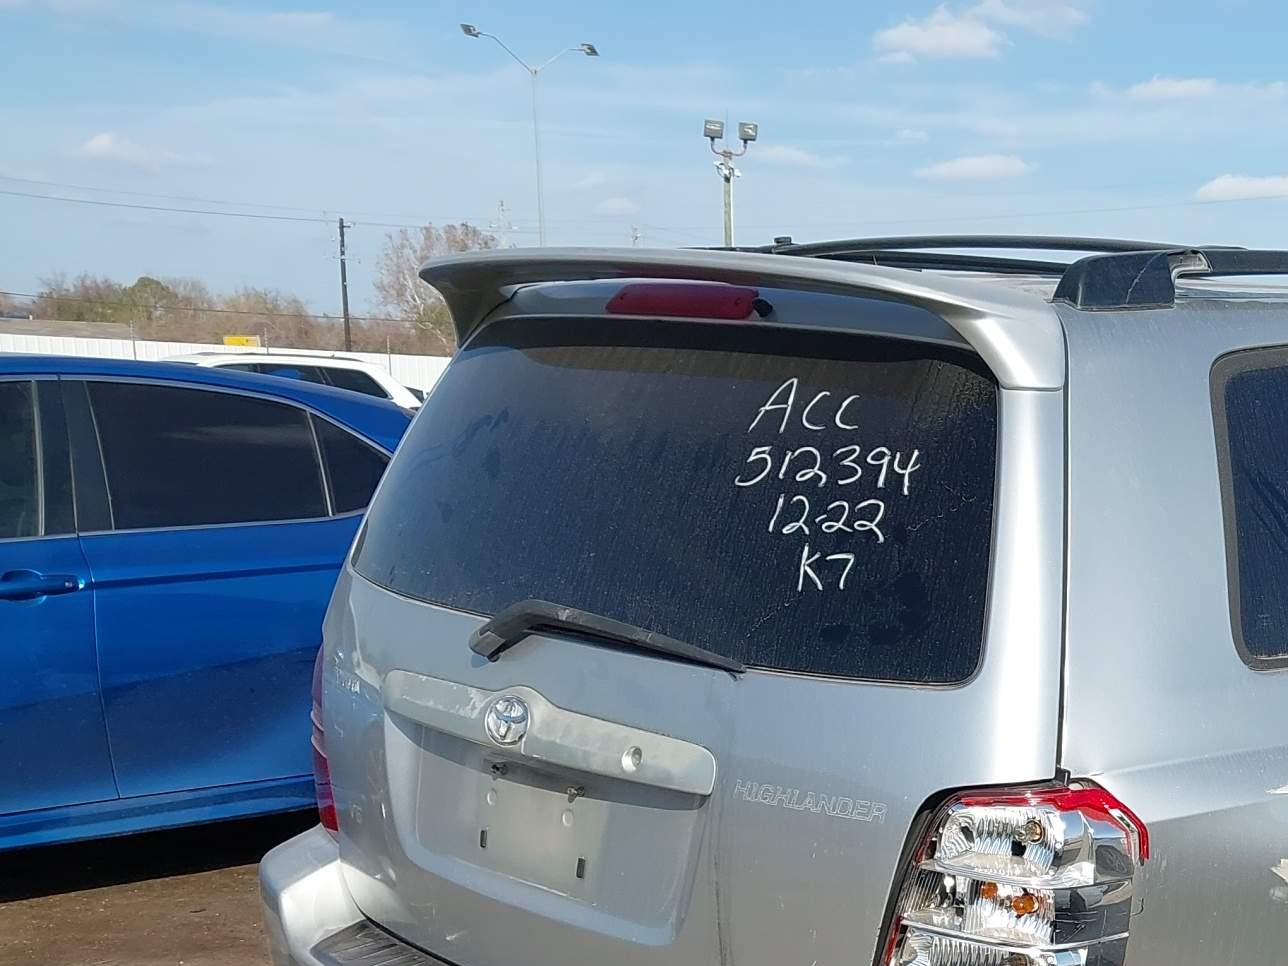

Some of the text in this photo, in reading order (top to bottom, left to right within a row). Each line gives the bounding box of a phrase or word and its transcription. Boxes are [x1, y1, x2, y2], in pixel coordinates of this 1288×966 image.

[748, 377, 860, 434] ACC
[734, 444, 921, 496] 512394
[768, 493, 885, 544] 12-22
[797, 542, 855, 592] K7
[733, 779, 888, 824] HIGHLANDER
